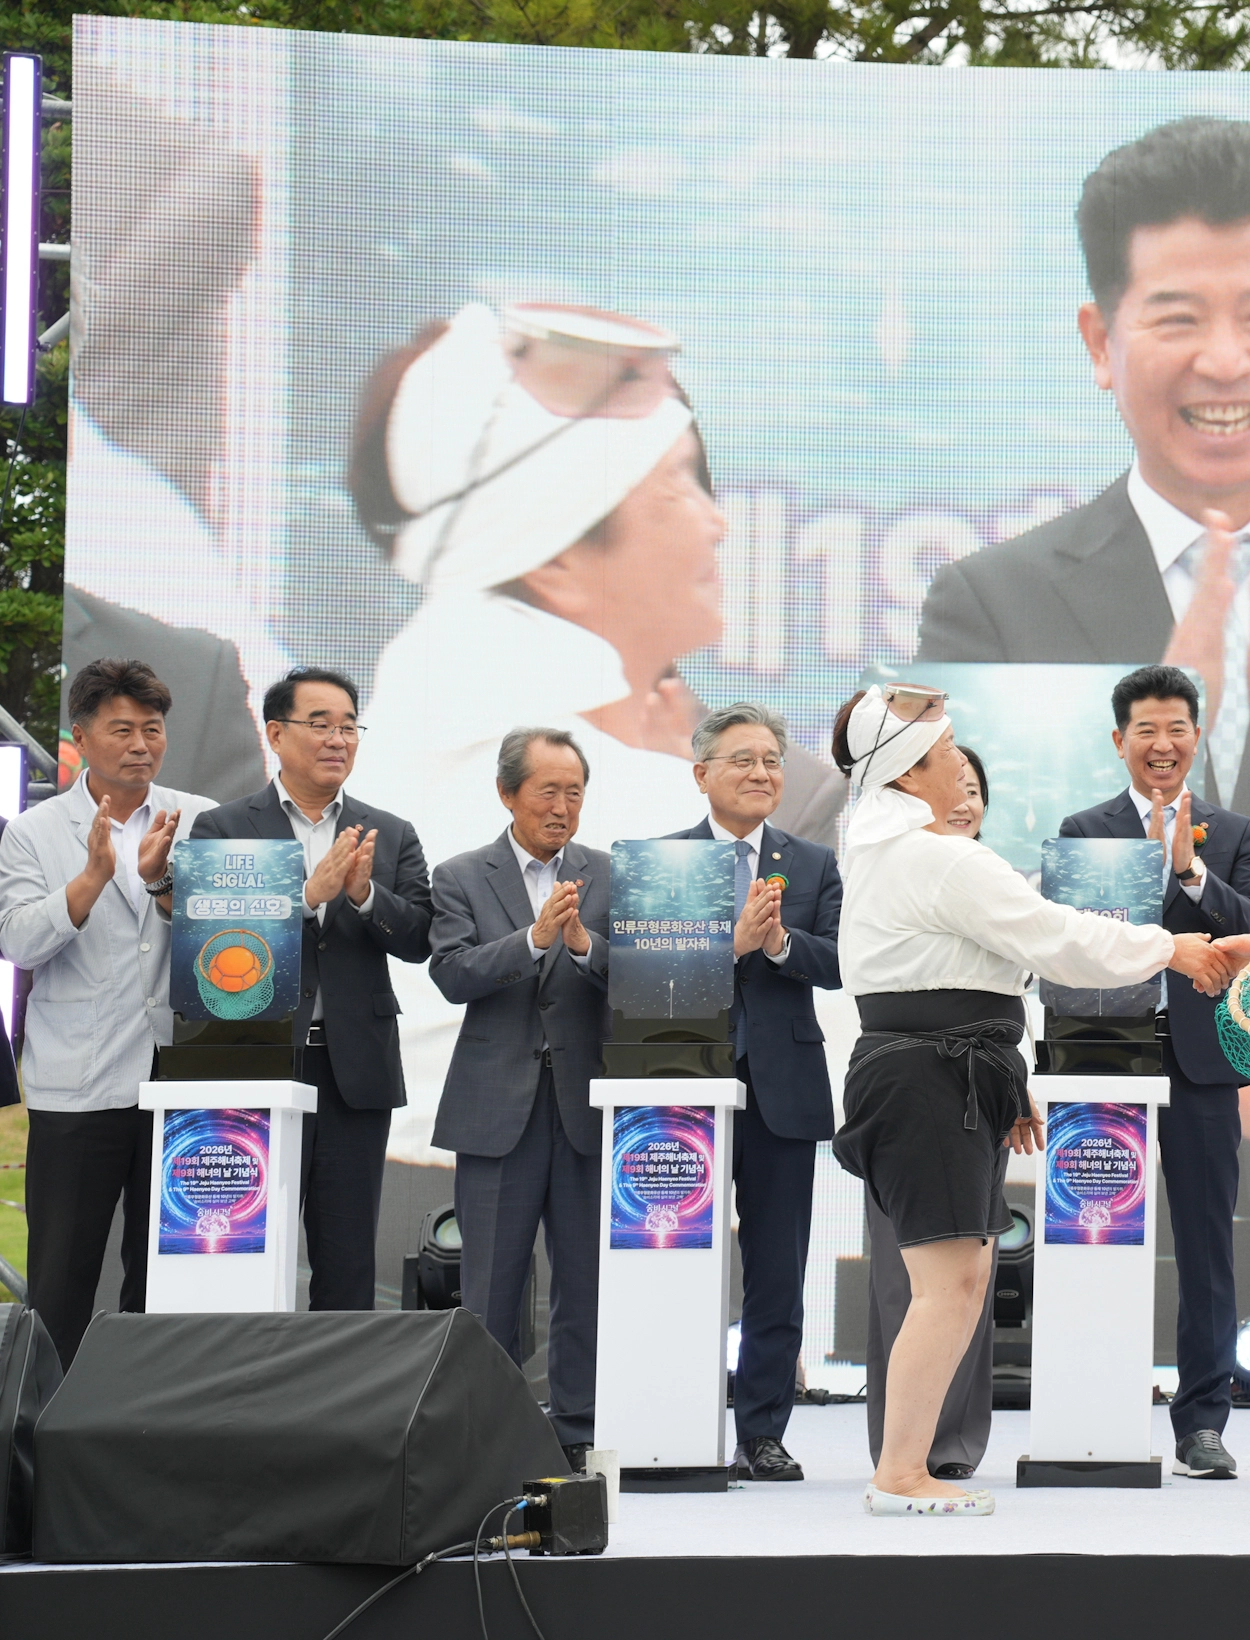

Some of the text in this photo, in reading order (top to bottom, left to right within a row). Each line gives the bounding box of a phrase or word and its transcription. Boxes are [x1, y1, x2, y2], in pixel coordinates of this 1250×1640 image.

[224, 854, 254, 870] LIFE
[212, 872, 264, 888] SIGLAL
[194, 898, 281, 916] 생명의 신호
[613, 920, 732, 934] 인류무형문화유산 등재
[634, 937, 710, 951] 10년의 발자취
[648, 1142, 679, 1151] 2026년
[1081, 1138, 1112, 1148] 2026년
[200, 1145, 232, 1154] 2026년
[1056, 1149, 1081, 1158] 제19회
[1083, 1149, 1129, 1158] 제주해녀축제
[172, 1156, 199, 1166] 제19회
[201, 1156, 250, 1166] 제주해녀축제
[622, 1153, 648, 1162] 제19회
[649, 1152, 697, 1162] 제주해녀축제
[622, 1164, 704, 1174] 제9회 해녀의 날 기념식
[1056, 1160, 1136, 1170] 제9회 해녀의 날 기념식
[172, 1167, 258, 1178] 제9회 해녀의 날 기념식
